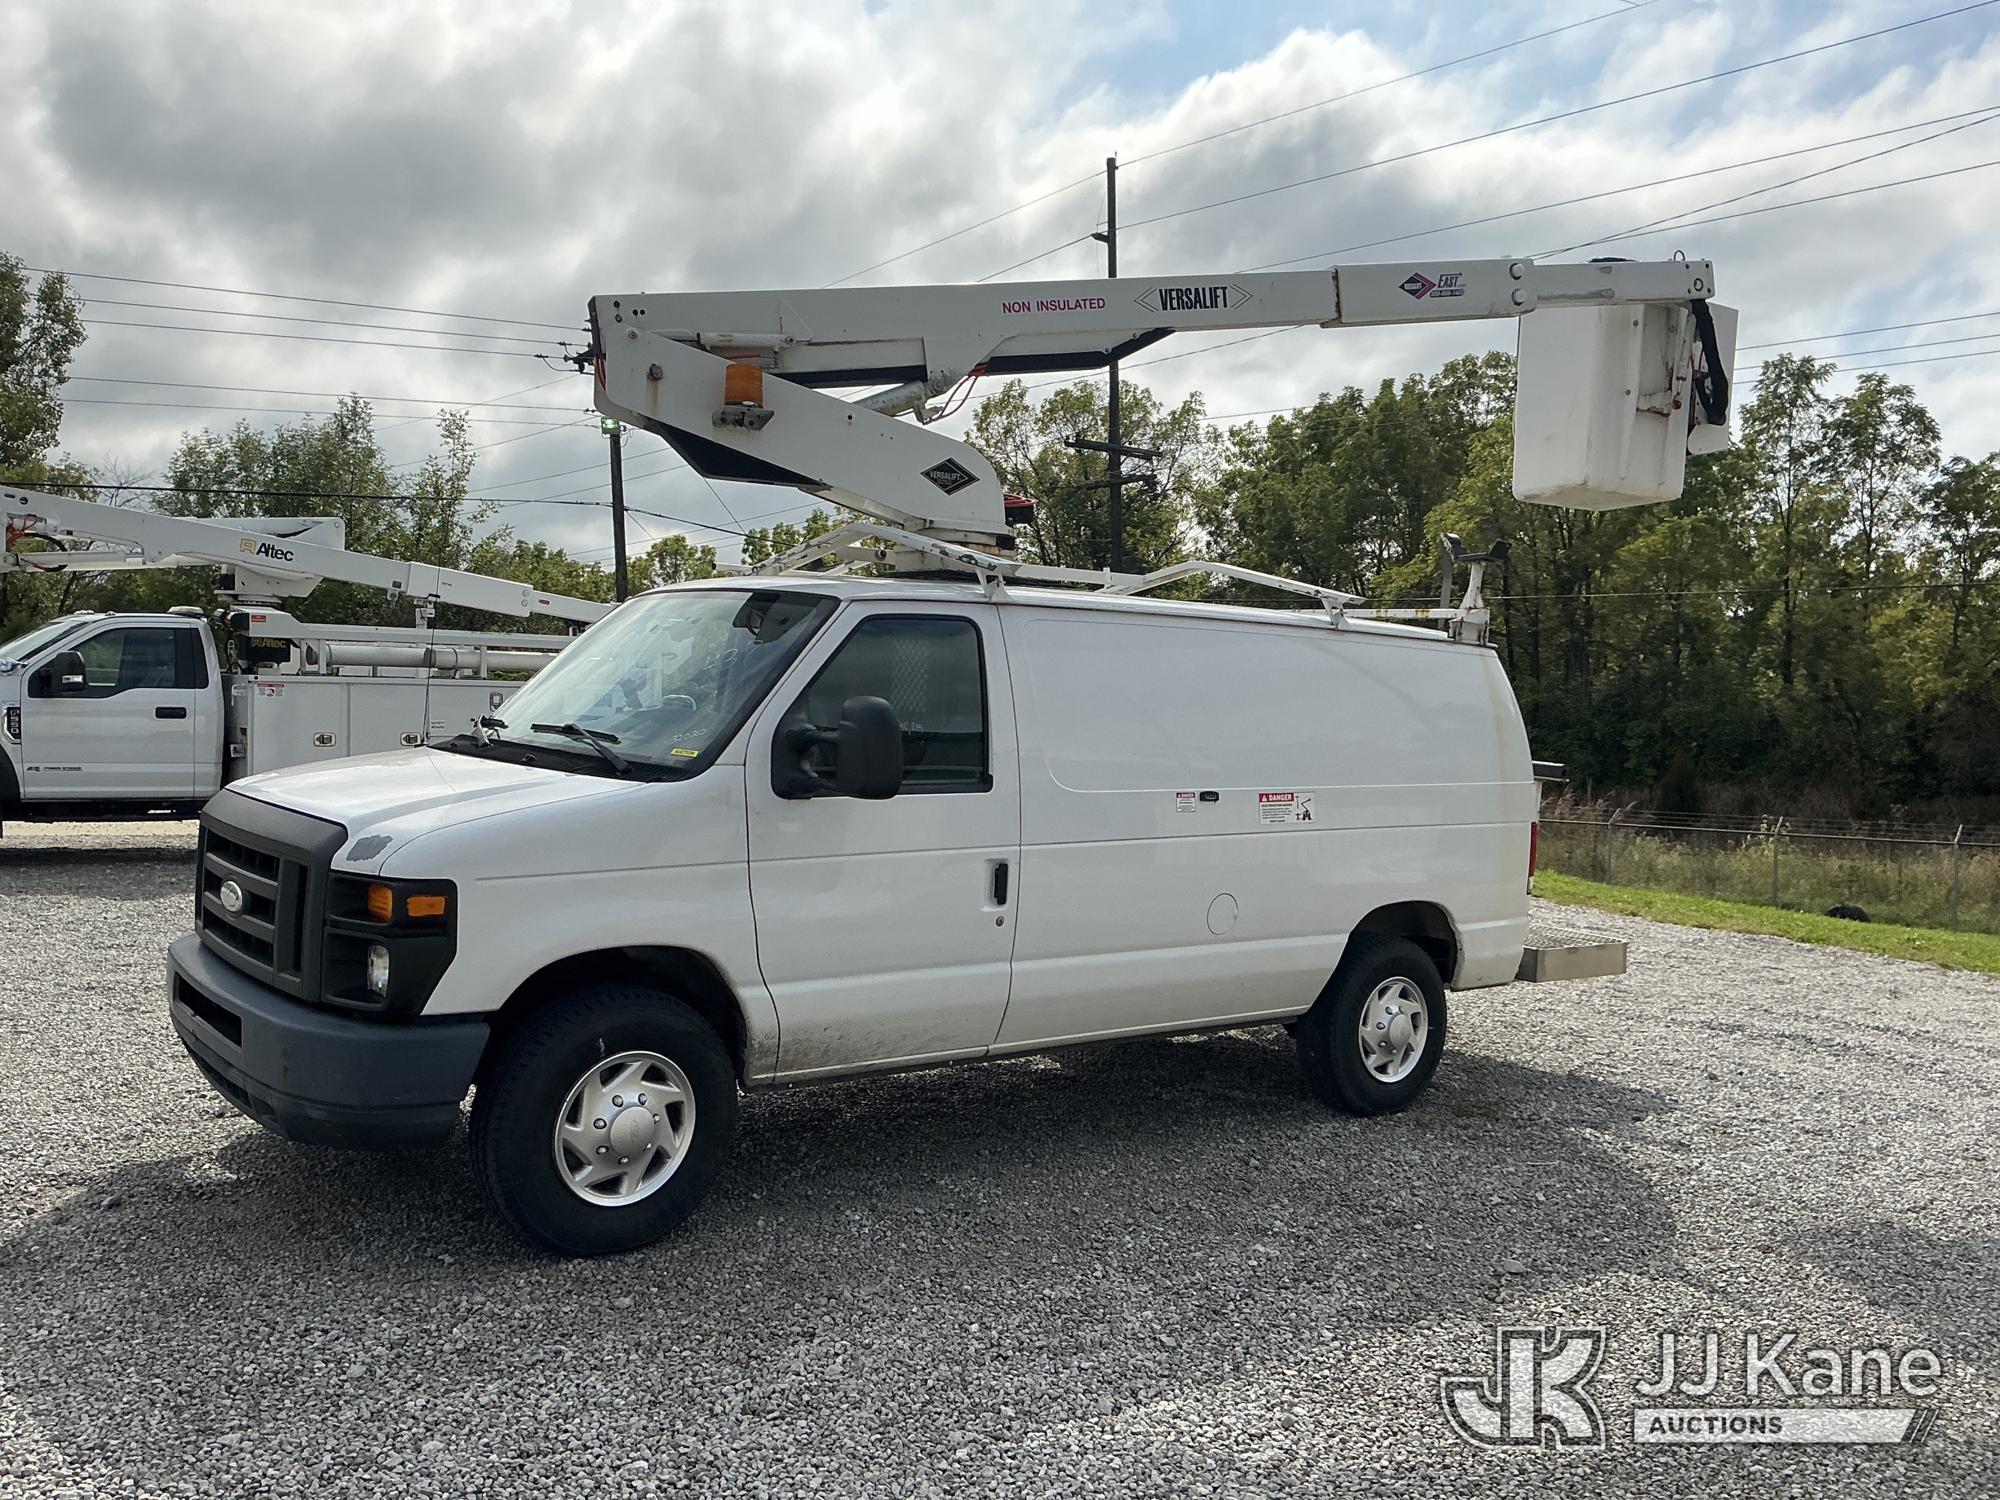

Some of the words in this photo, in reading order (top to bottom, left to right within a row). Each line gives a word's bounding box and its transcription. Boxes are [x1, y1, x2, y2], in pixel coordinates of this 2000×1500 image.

[1437, 273, 1460, 289] EAST
[1002, 301, 1032, 314] NON
[1036, 297, 1106, 312] INSULATED
[1158, 286, 1229, 311] VERSALIFT
[929, 470, 961, 481] VERSALIFT
[256, 542, 294, 562] Altec
[263, 637, 287, 648] Altec
[1268, 794, 1292, 802] DANGER
